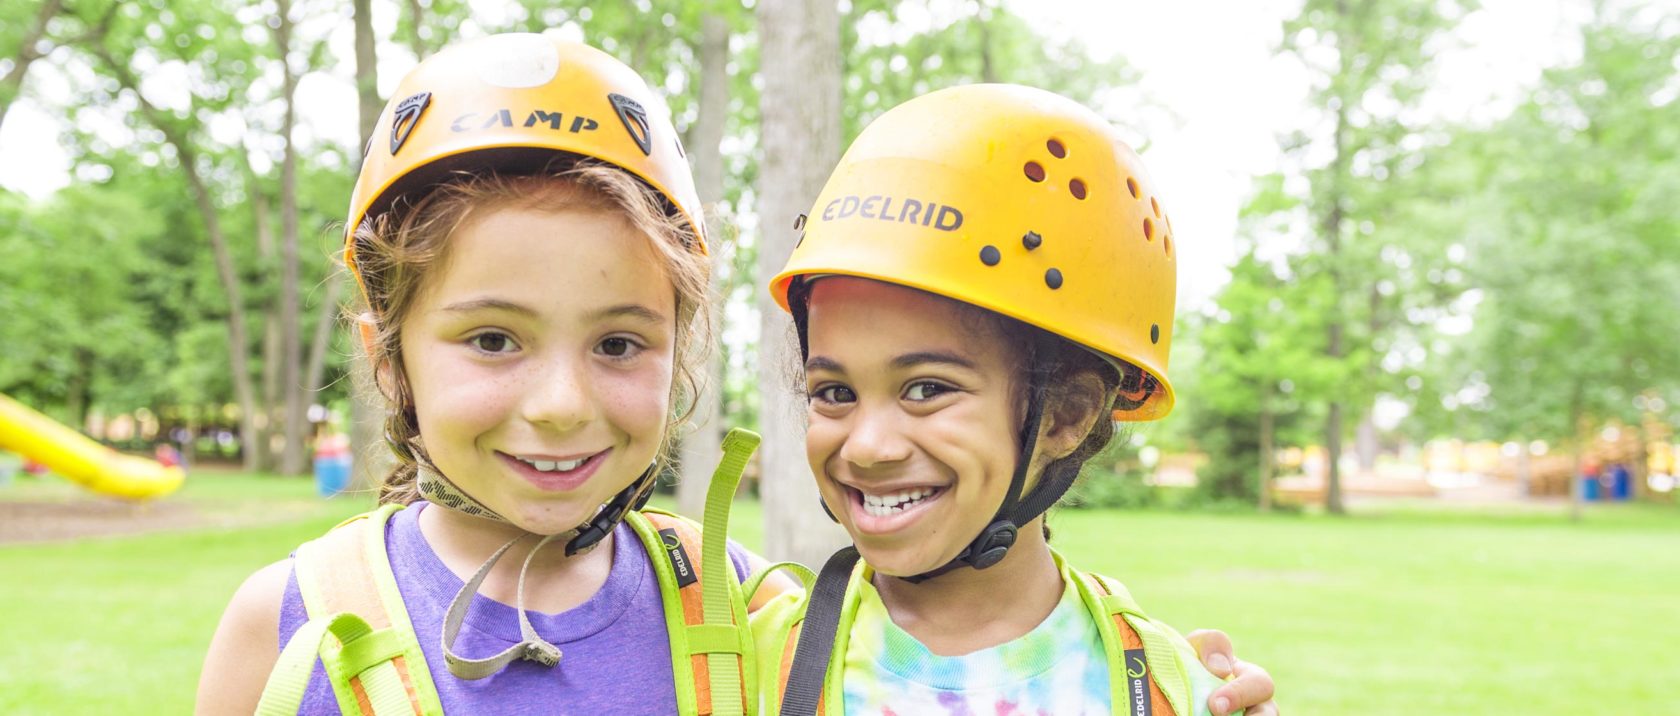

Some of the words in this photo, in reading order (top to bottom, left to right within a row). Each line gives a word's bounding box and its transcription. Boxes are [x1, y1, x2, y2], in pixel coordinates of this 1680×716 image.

[450, 109, 599, 133] CAMP
[821, 195, 964, 232] EDELRID
[1134, 679, 1145, 716] EDELRID
